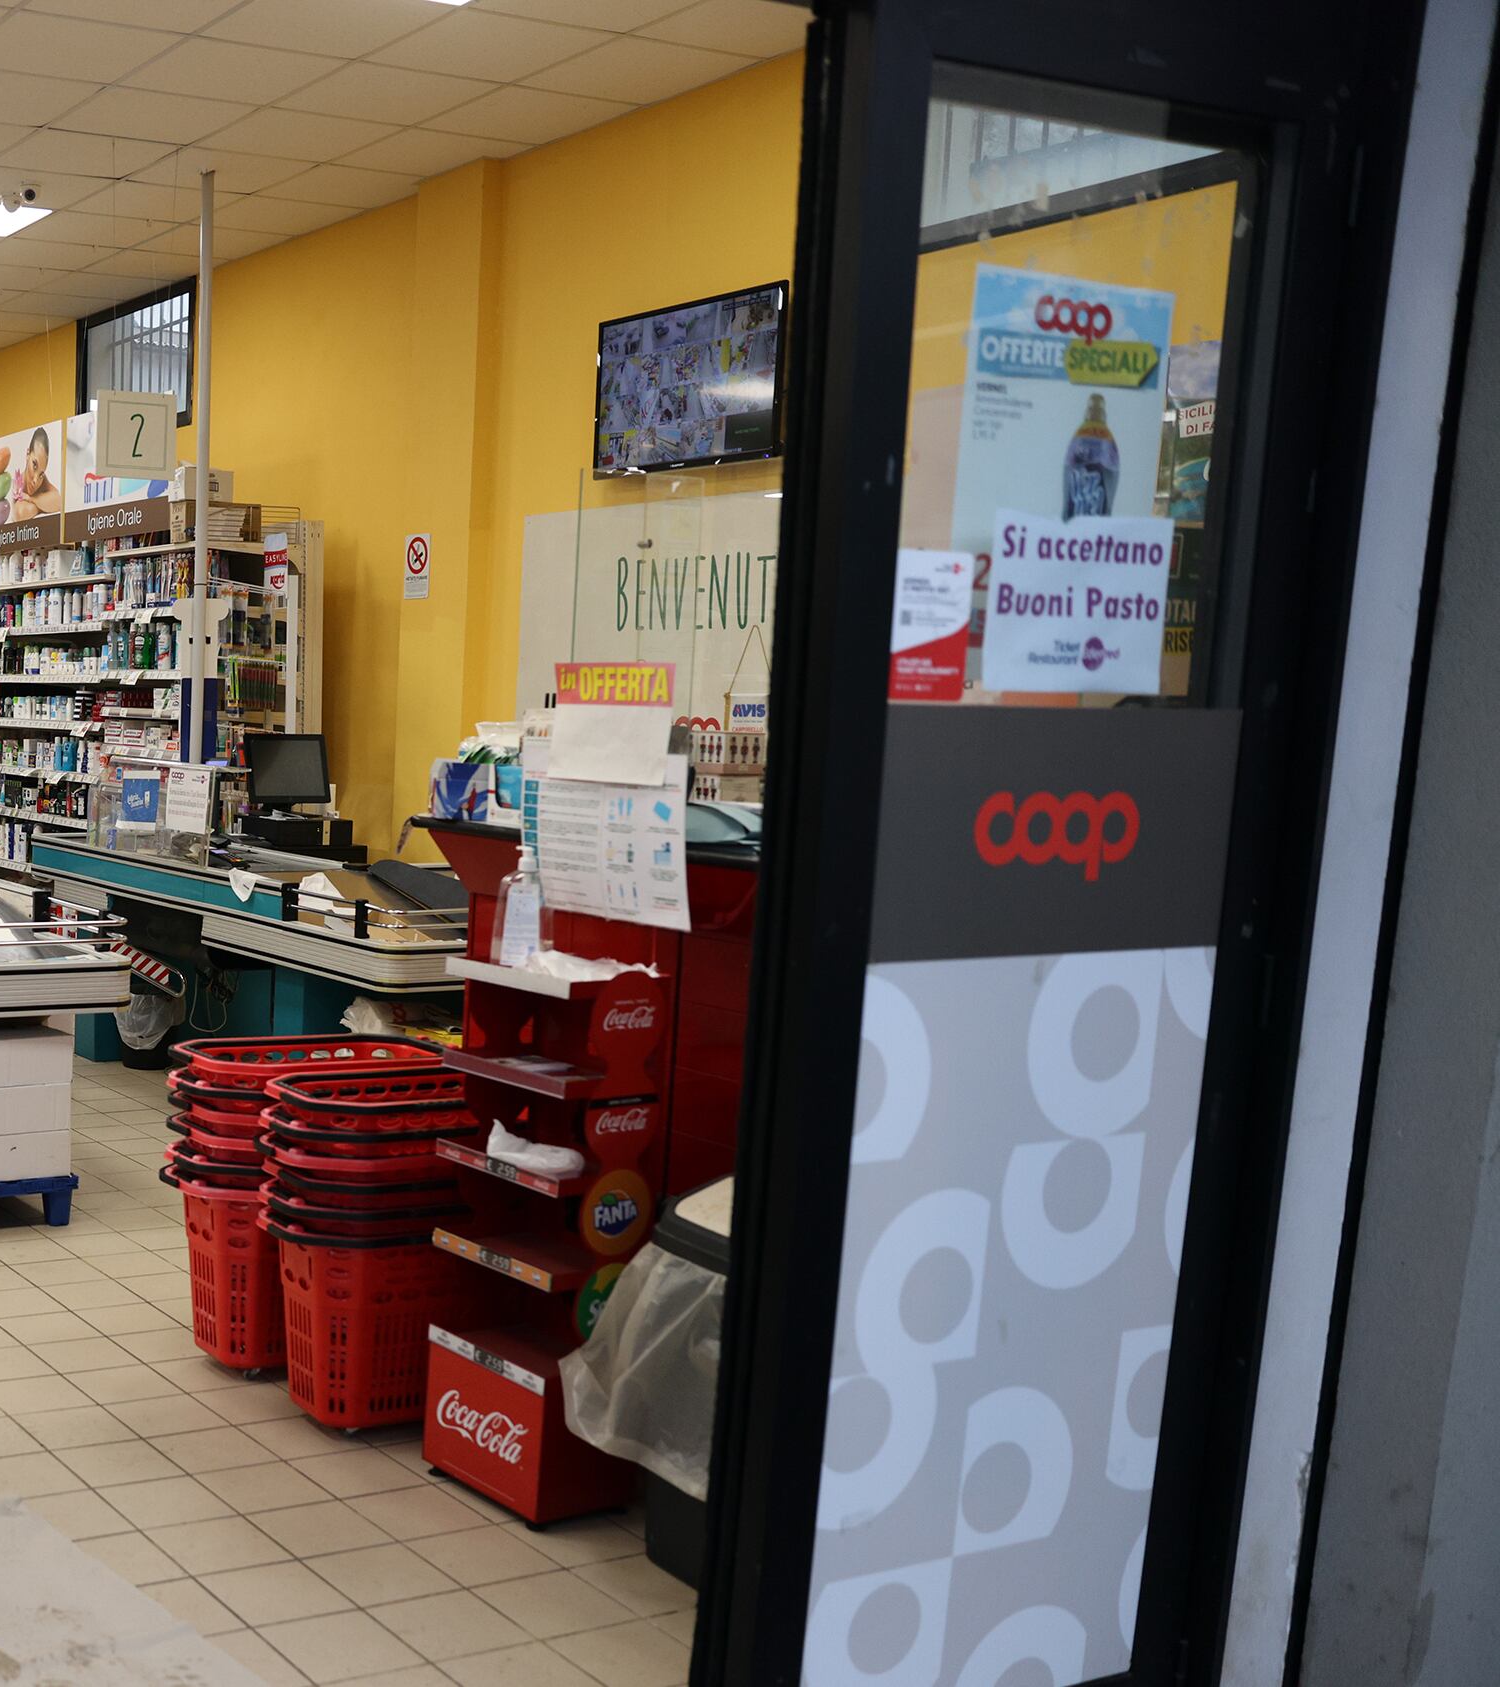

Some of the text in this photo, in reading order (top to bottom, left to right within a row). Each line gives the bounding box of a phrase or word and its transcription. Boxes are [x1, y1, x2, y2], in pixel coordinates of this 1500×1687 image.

[1035, 295, 1113, 346] coop
[981, 335, 1149, 374] OFFERTE SPECIALI
[1177, 404, 1217, 421] SICILI
[1186, 423, 1199, 435] DI
[130, 413, 145, 458] 2
[16, 524, 40, 543] Intima
[87, 506, 143, 535] Igiene Orale
[1002, 524, 1164, 566] Si accettano
[996, 583, 1160, 622] Buoni Pasto
[560, 667, 669, 703] in OFFERTA
[732, 703, 766, 718] AVIS
[171, 771, 185, 780] coop
[973, 790, 1141, 881] coop
[593, 1199, 638, 1229] FANTA
